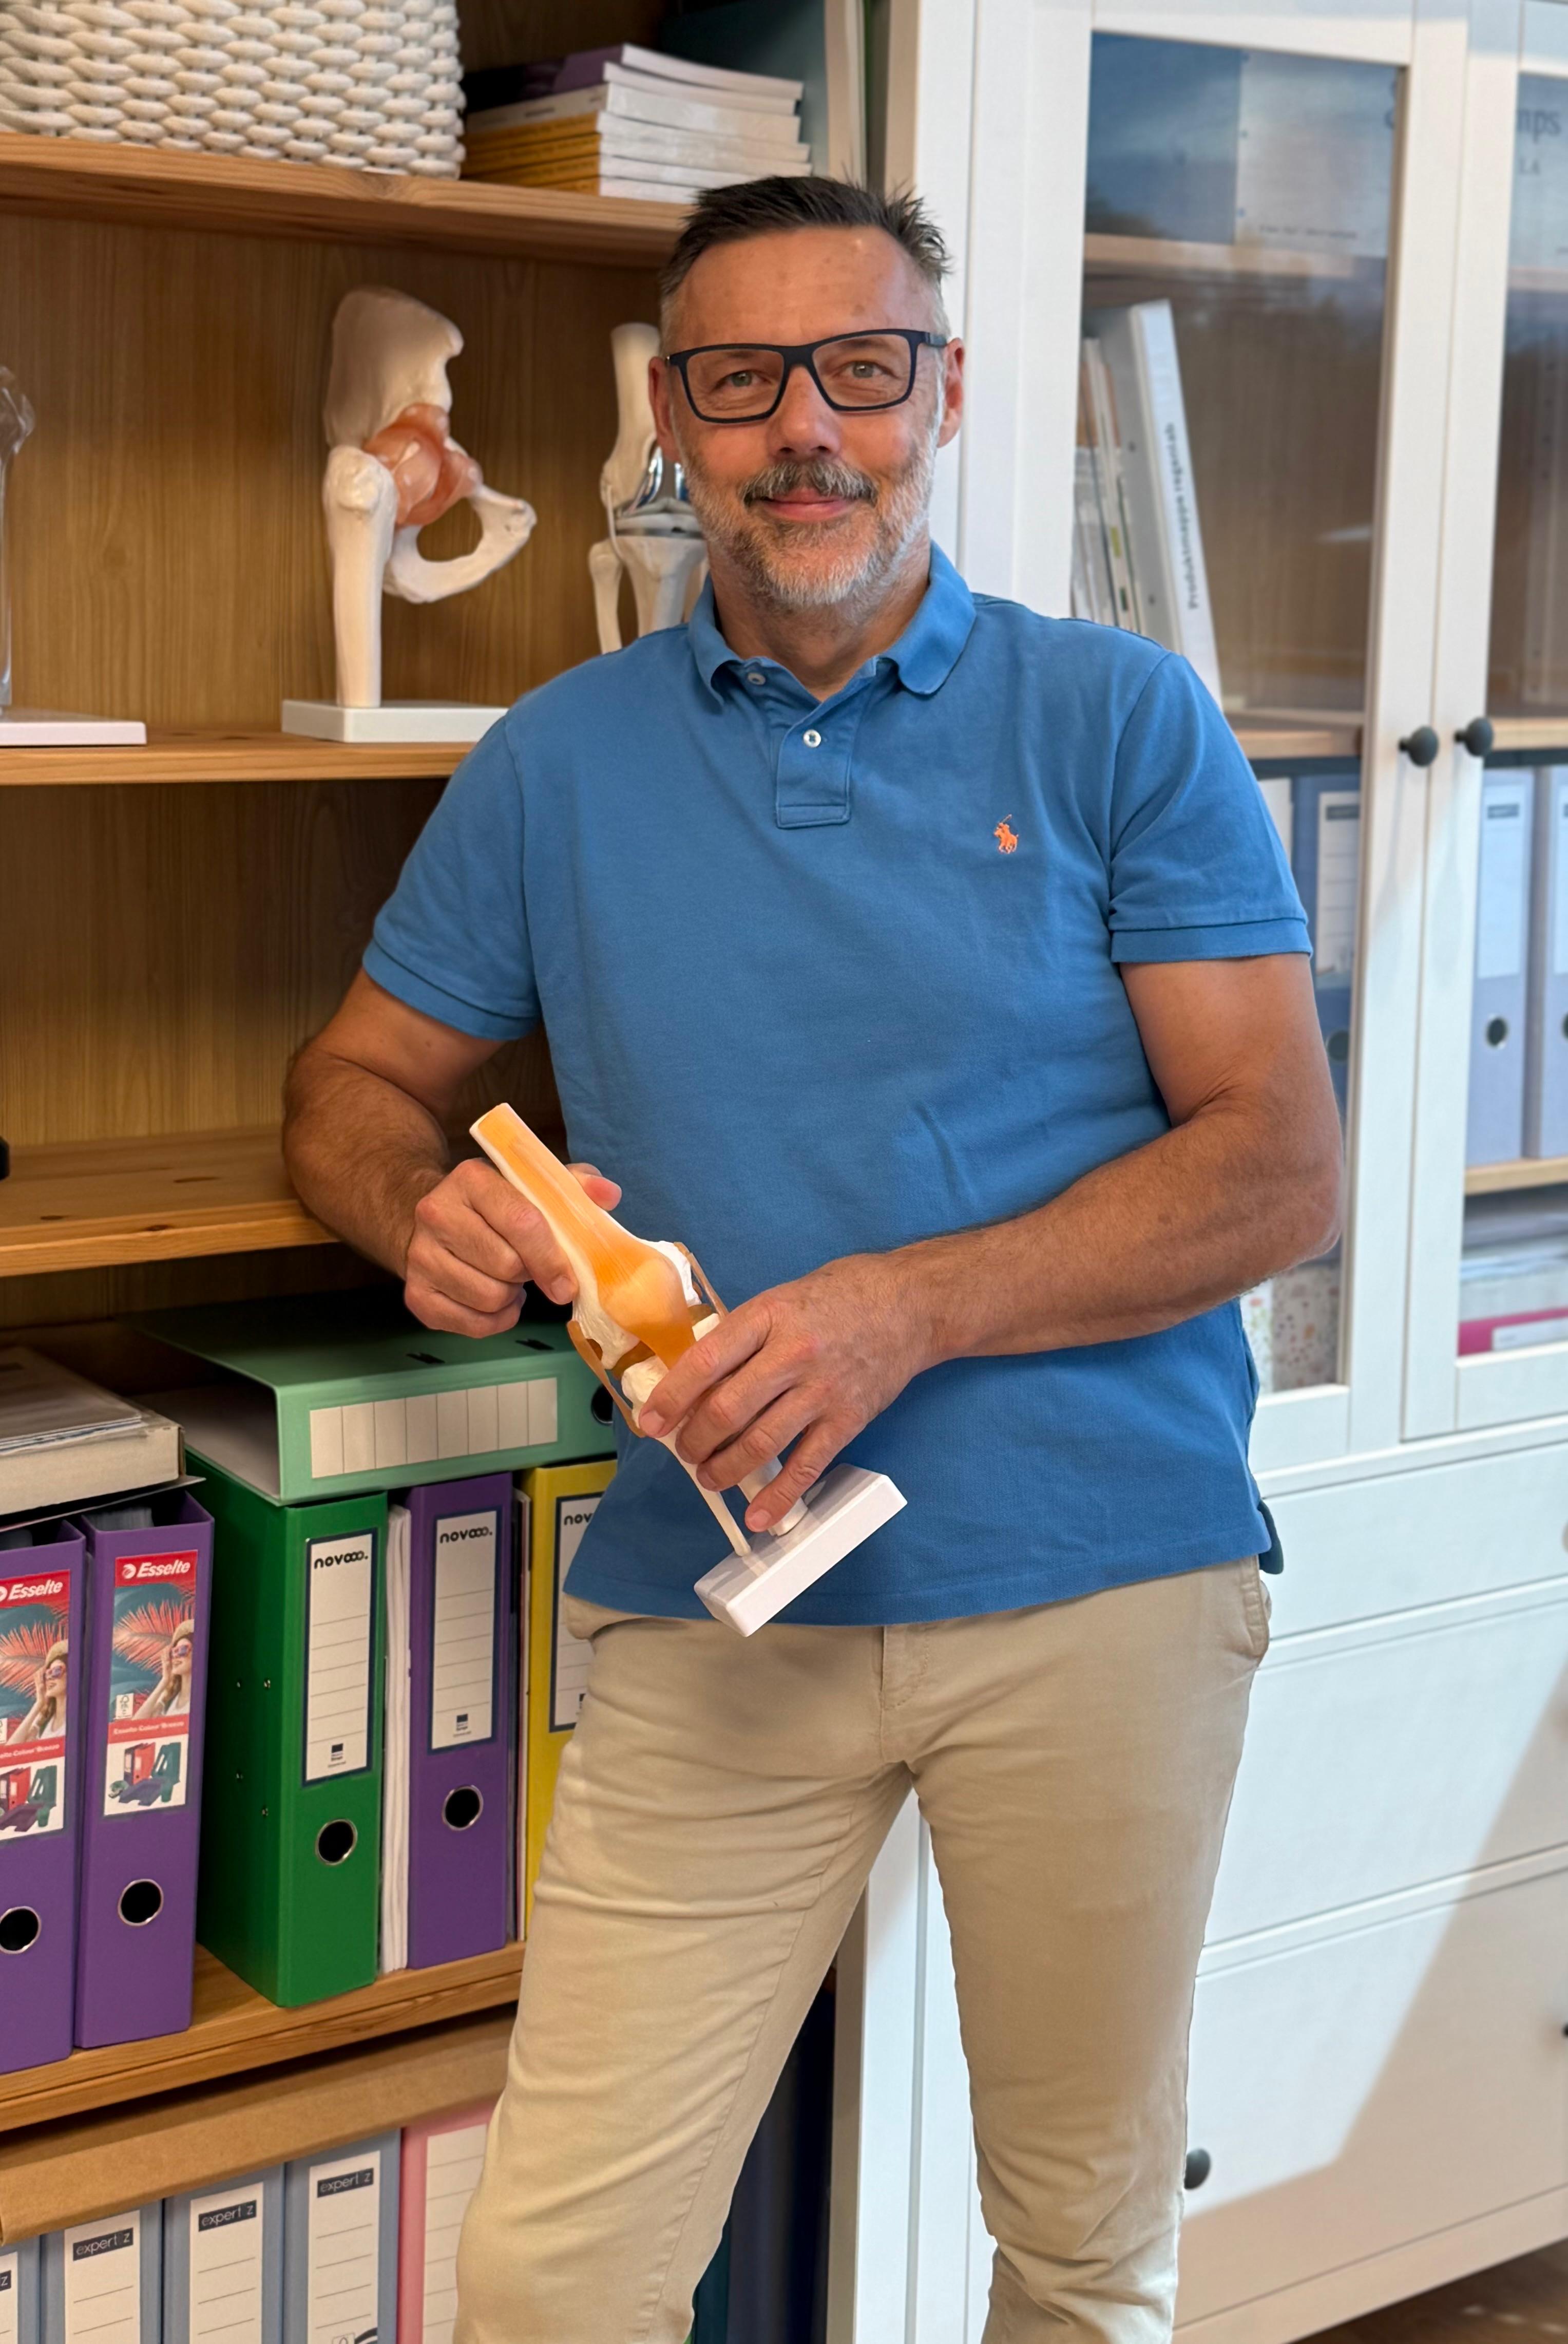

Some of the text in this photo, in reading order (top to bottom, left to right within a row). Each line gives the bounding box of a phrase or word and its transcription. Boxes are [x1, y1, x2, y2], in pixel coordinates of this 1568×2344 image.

[137, 1559, 190, 1578] Esselte
[8, 1579, 63, 1600] Esselte
[320, 2172, 358, 2192] expert
[201, 2205, 241, 2226] expert
[76, 2234, 118, 2255] expert
